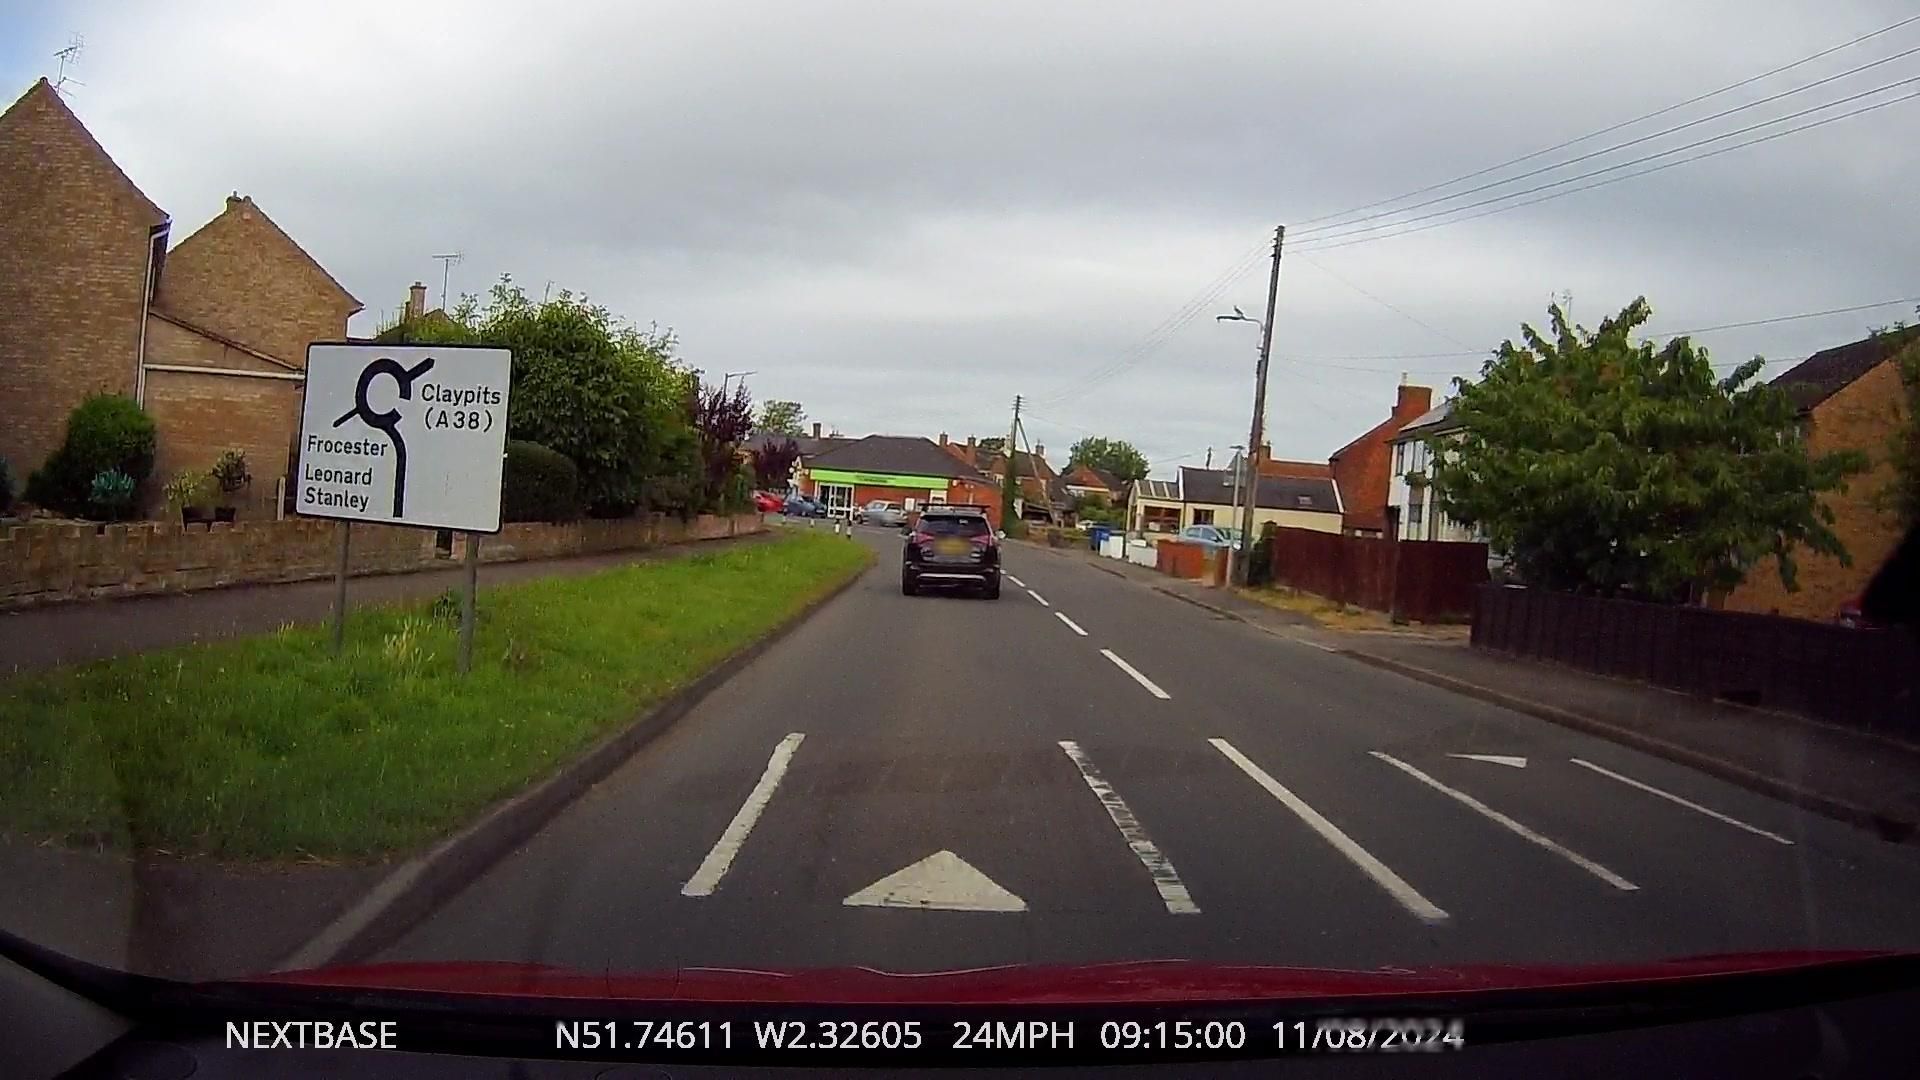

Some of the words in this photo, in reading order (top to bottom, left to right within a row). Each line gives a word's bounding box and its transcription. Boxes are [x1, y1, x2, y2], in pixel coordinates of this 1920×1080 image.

[421, 384, 501, 407] Claypits
[425, 407, 493, 432] (A38)
[307, 435, 388, 456] Frocester
[305, 464, 372, 485] Leonard
[304, 488, 369, 512] Stanley
